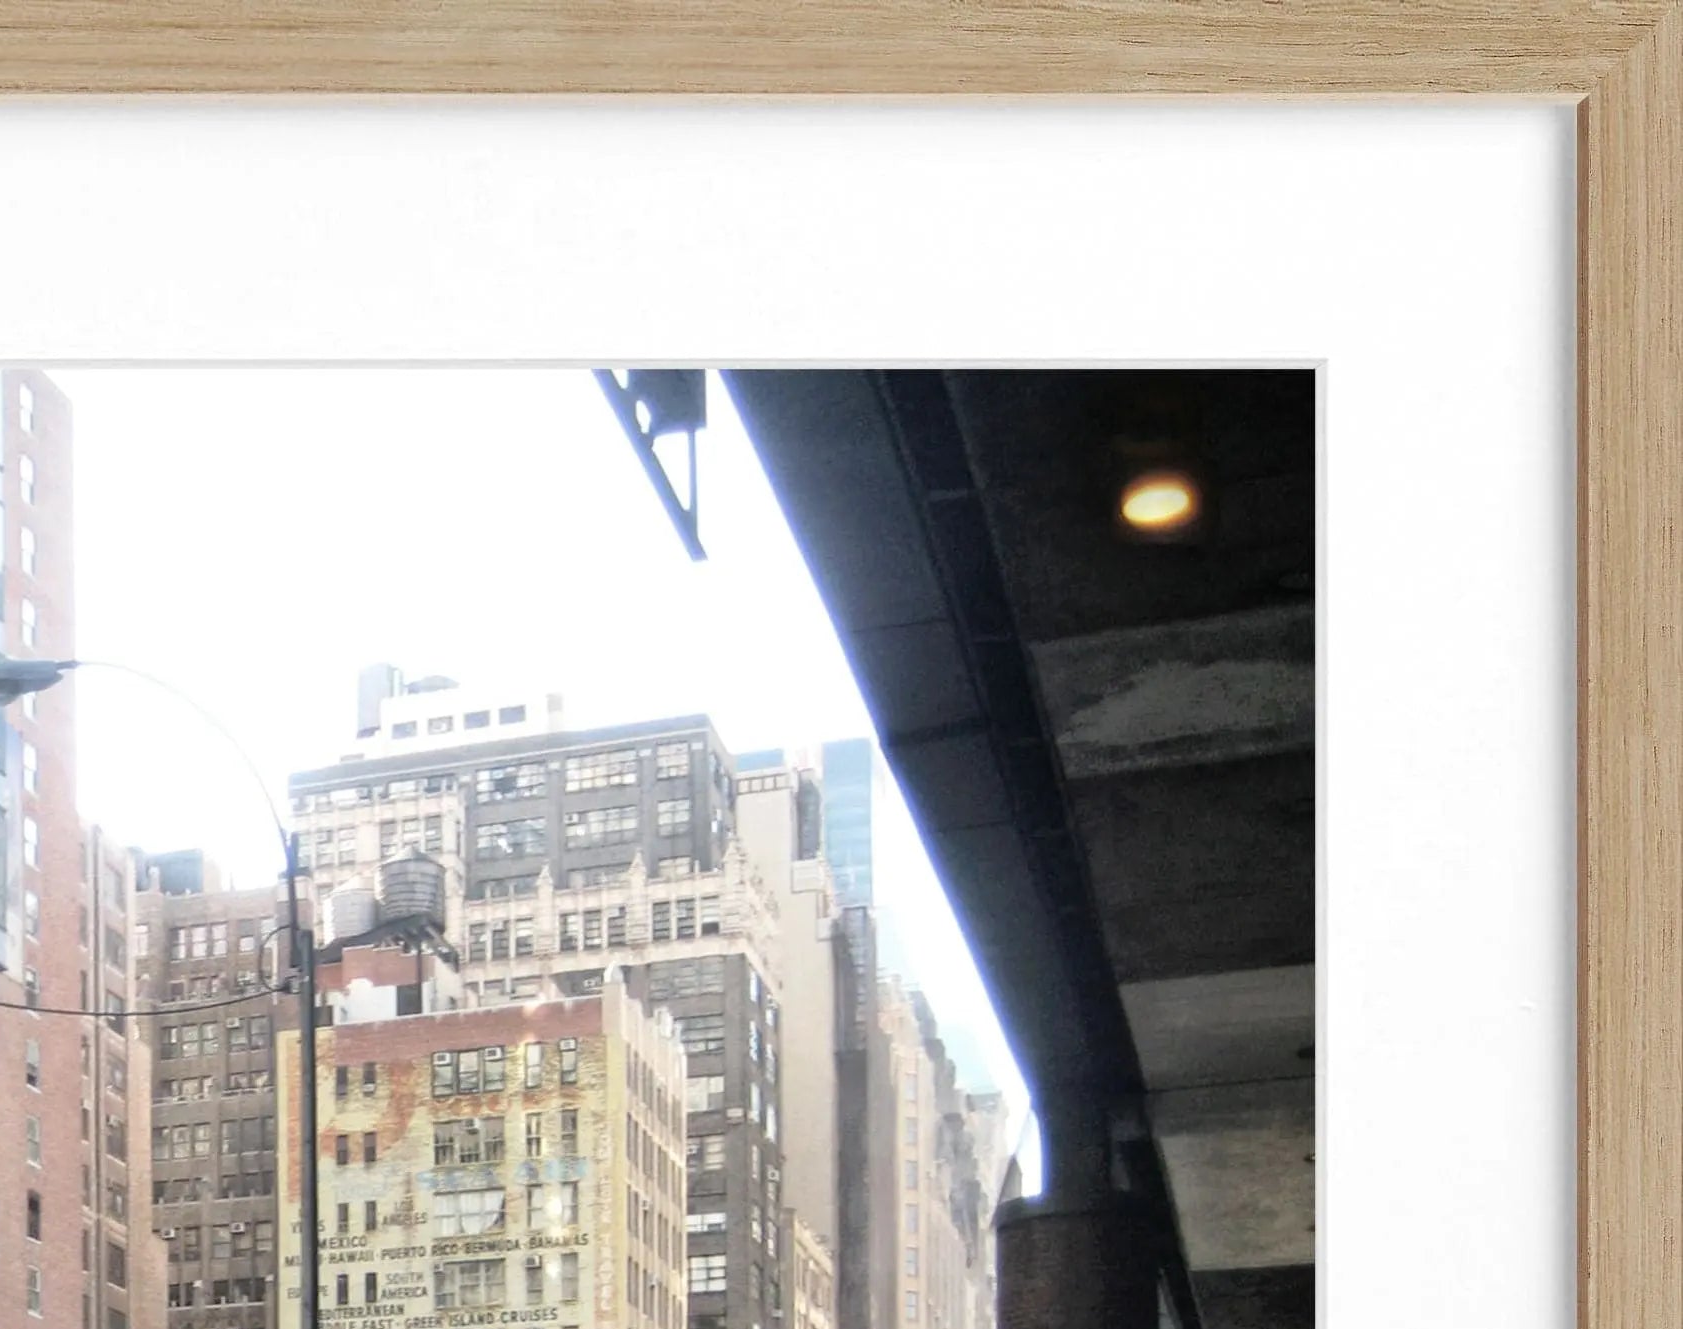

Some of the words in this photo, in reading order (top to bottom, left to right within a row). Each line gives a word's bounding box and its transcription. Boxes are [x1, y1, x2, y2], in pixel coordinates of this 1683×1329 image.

[382, 1212, 428, 1226] ANGELES
[318, 1235, 368, 1249] MEXICO
[328, 1250, 374, 1264] HAWAII
[381, 1246, 426, 1260] PUERTO
[431, 1243, 459, 1257] RICO
[464, 1239, 520, 1254] BERMUDA
[529, 1233, 589, 1249] BAHAMAS
[385, 1271, 424, 1285] SOUTH
[381, 1286, 428, 1300] AMERICA
[317, 1304, 405, 1321] EDITERRANEAN
[404, 1316, 444, 1329] GREEK
[448, 1312, 494, 1327] ISLAND
[500, 1307, 558, 1324] CRUISES
